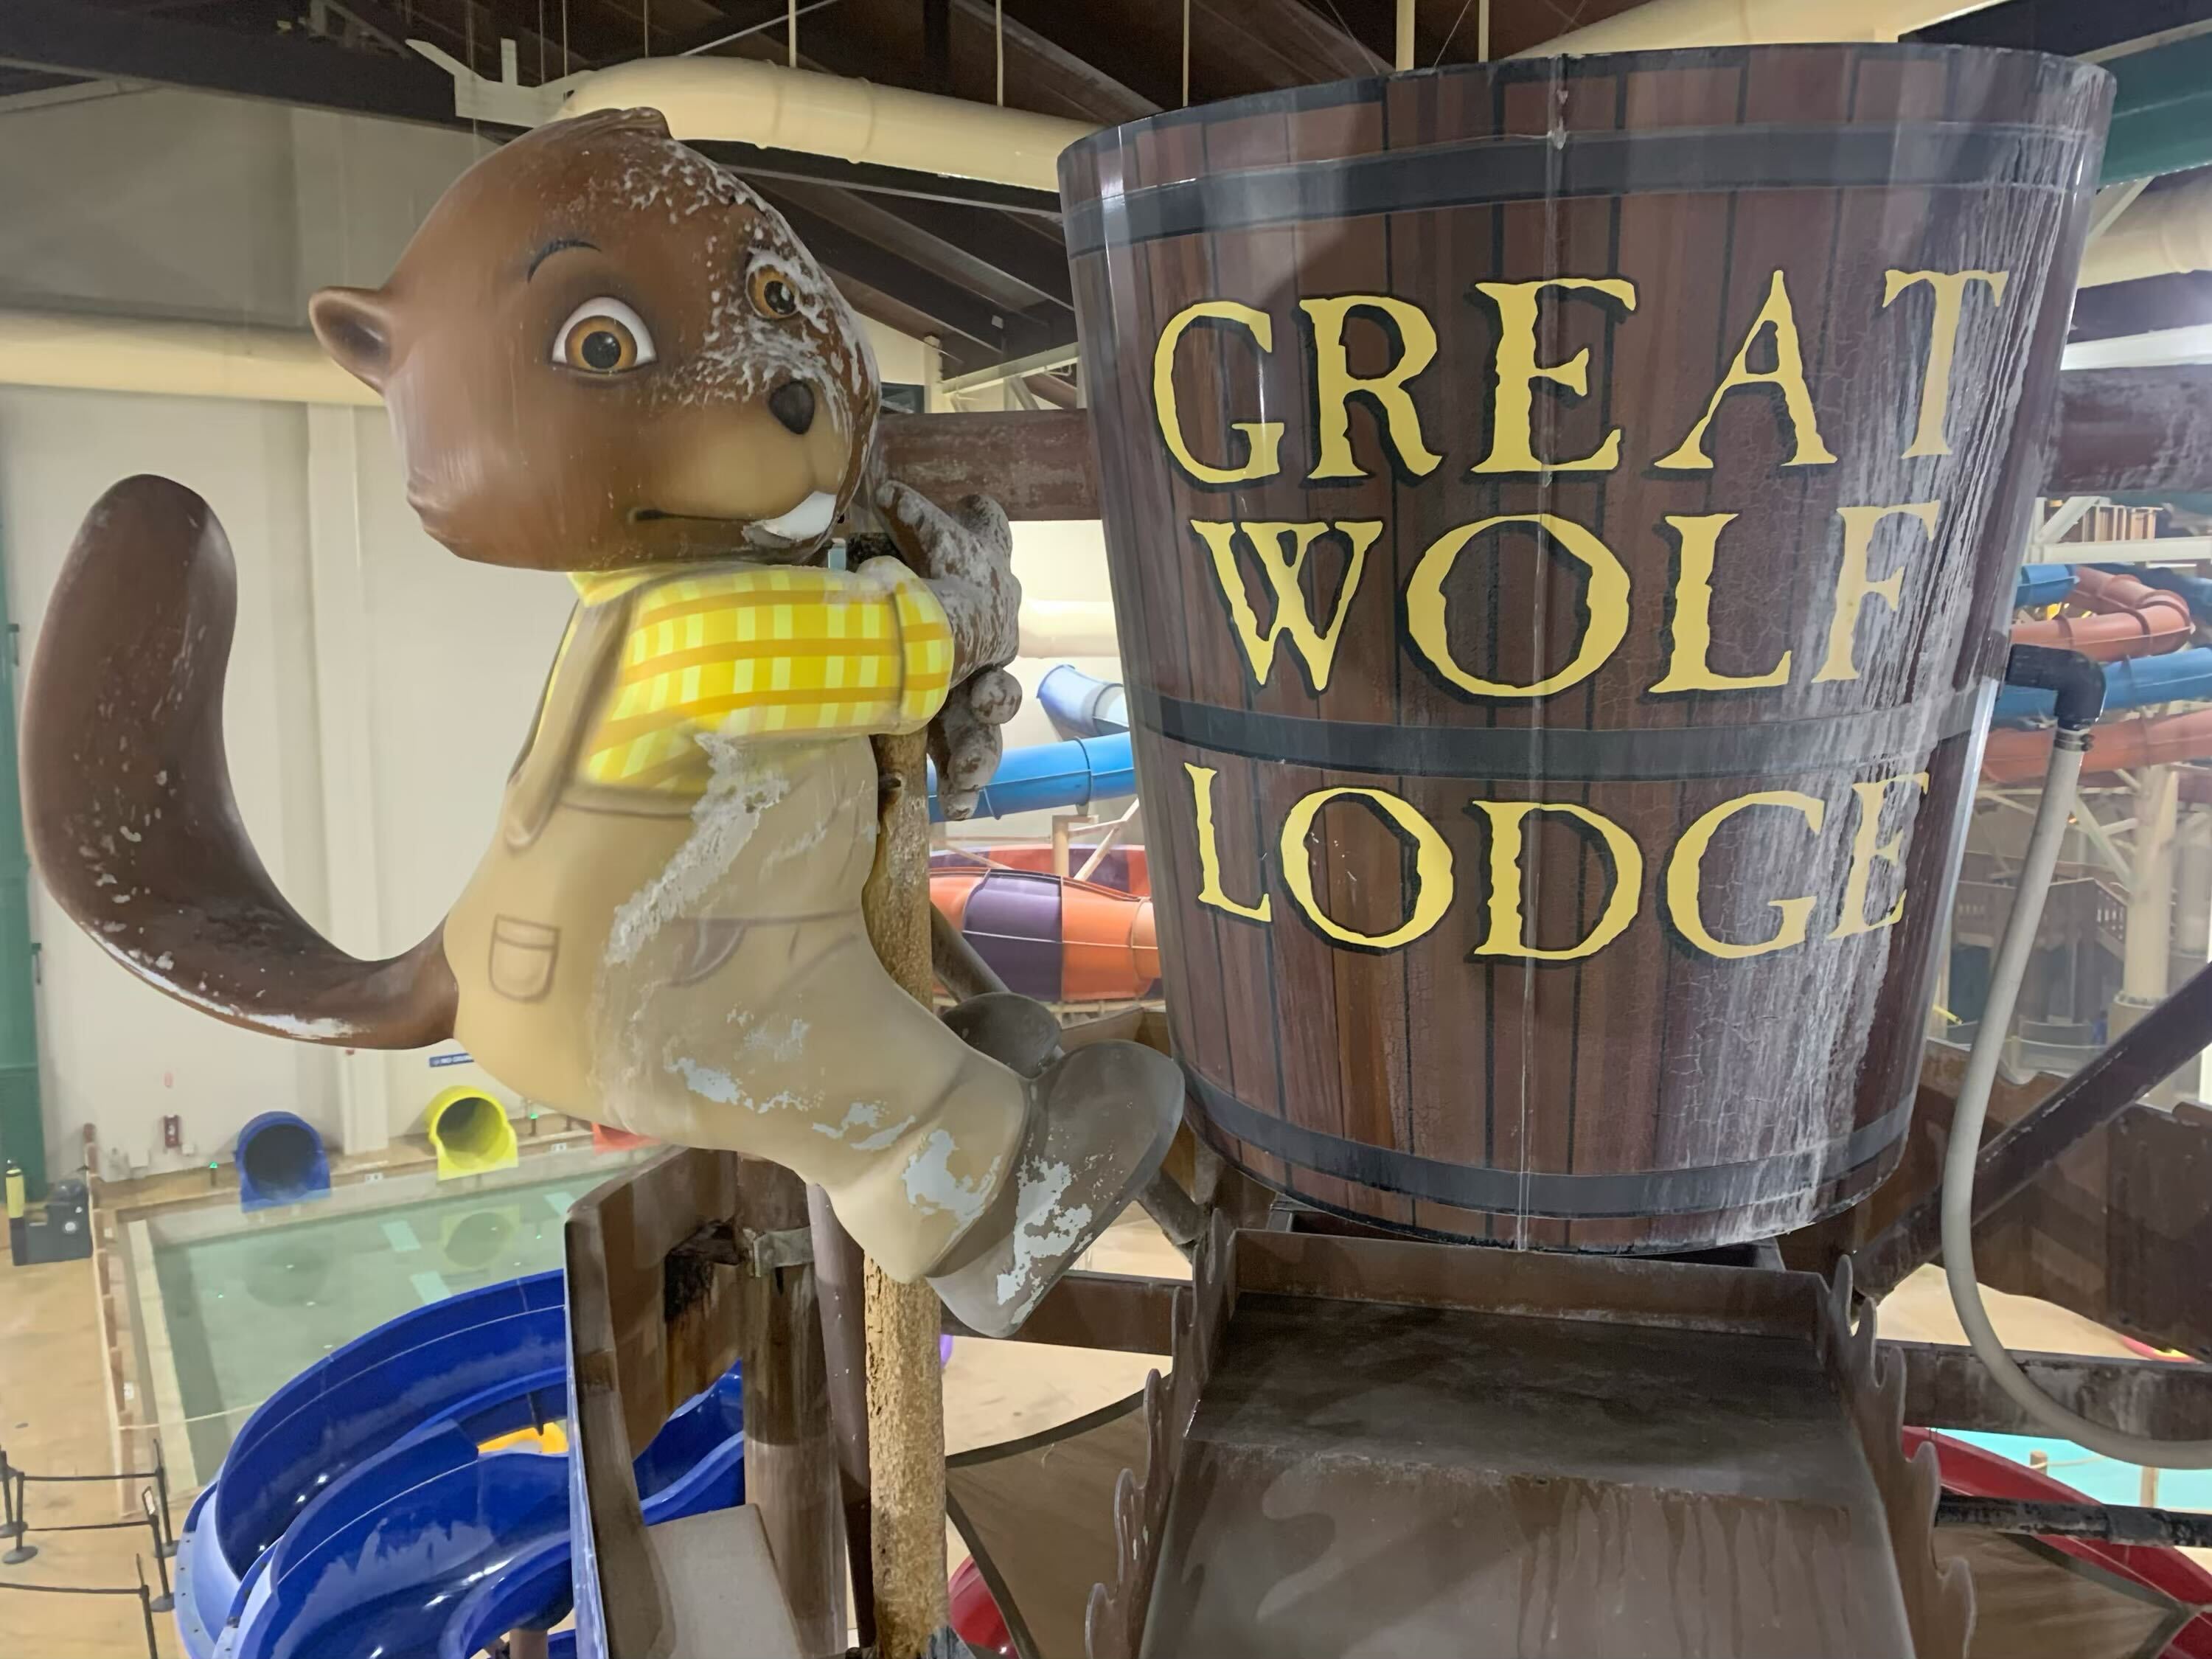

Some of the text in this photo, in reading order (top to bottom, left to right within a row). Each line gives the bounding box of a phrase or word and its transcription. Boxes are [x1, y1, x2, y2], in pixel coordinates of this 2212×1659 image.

[1153, 270, 2009, 483] GREAT
[1190, 501, 1941, 697] WOLF
[1184, 762, 1929, 961] LODGE
